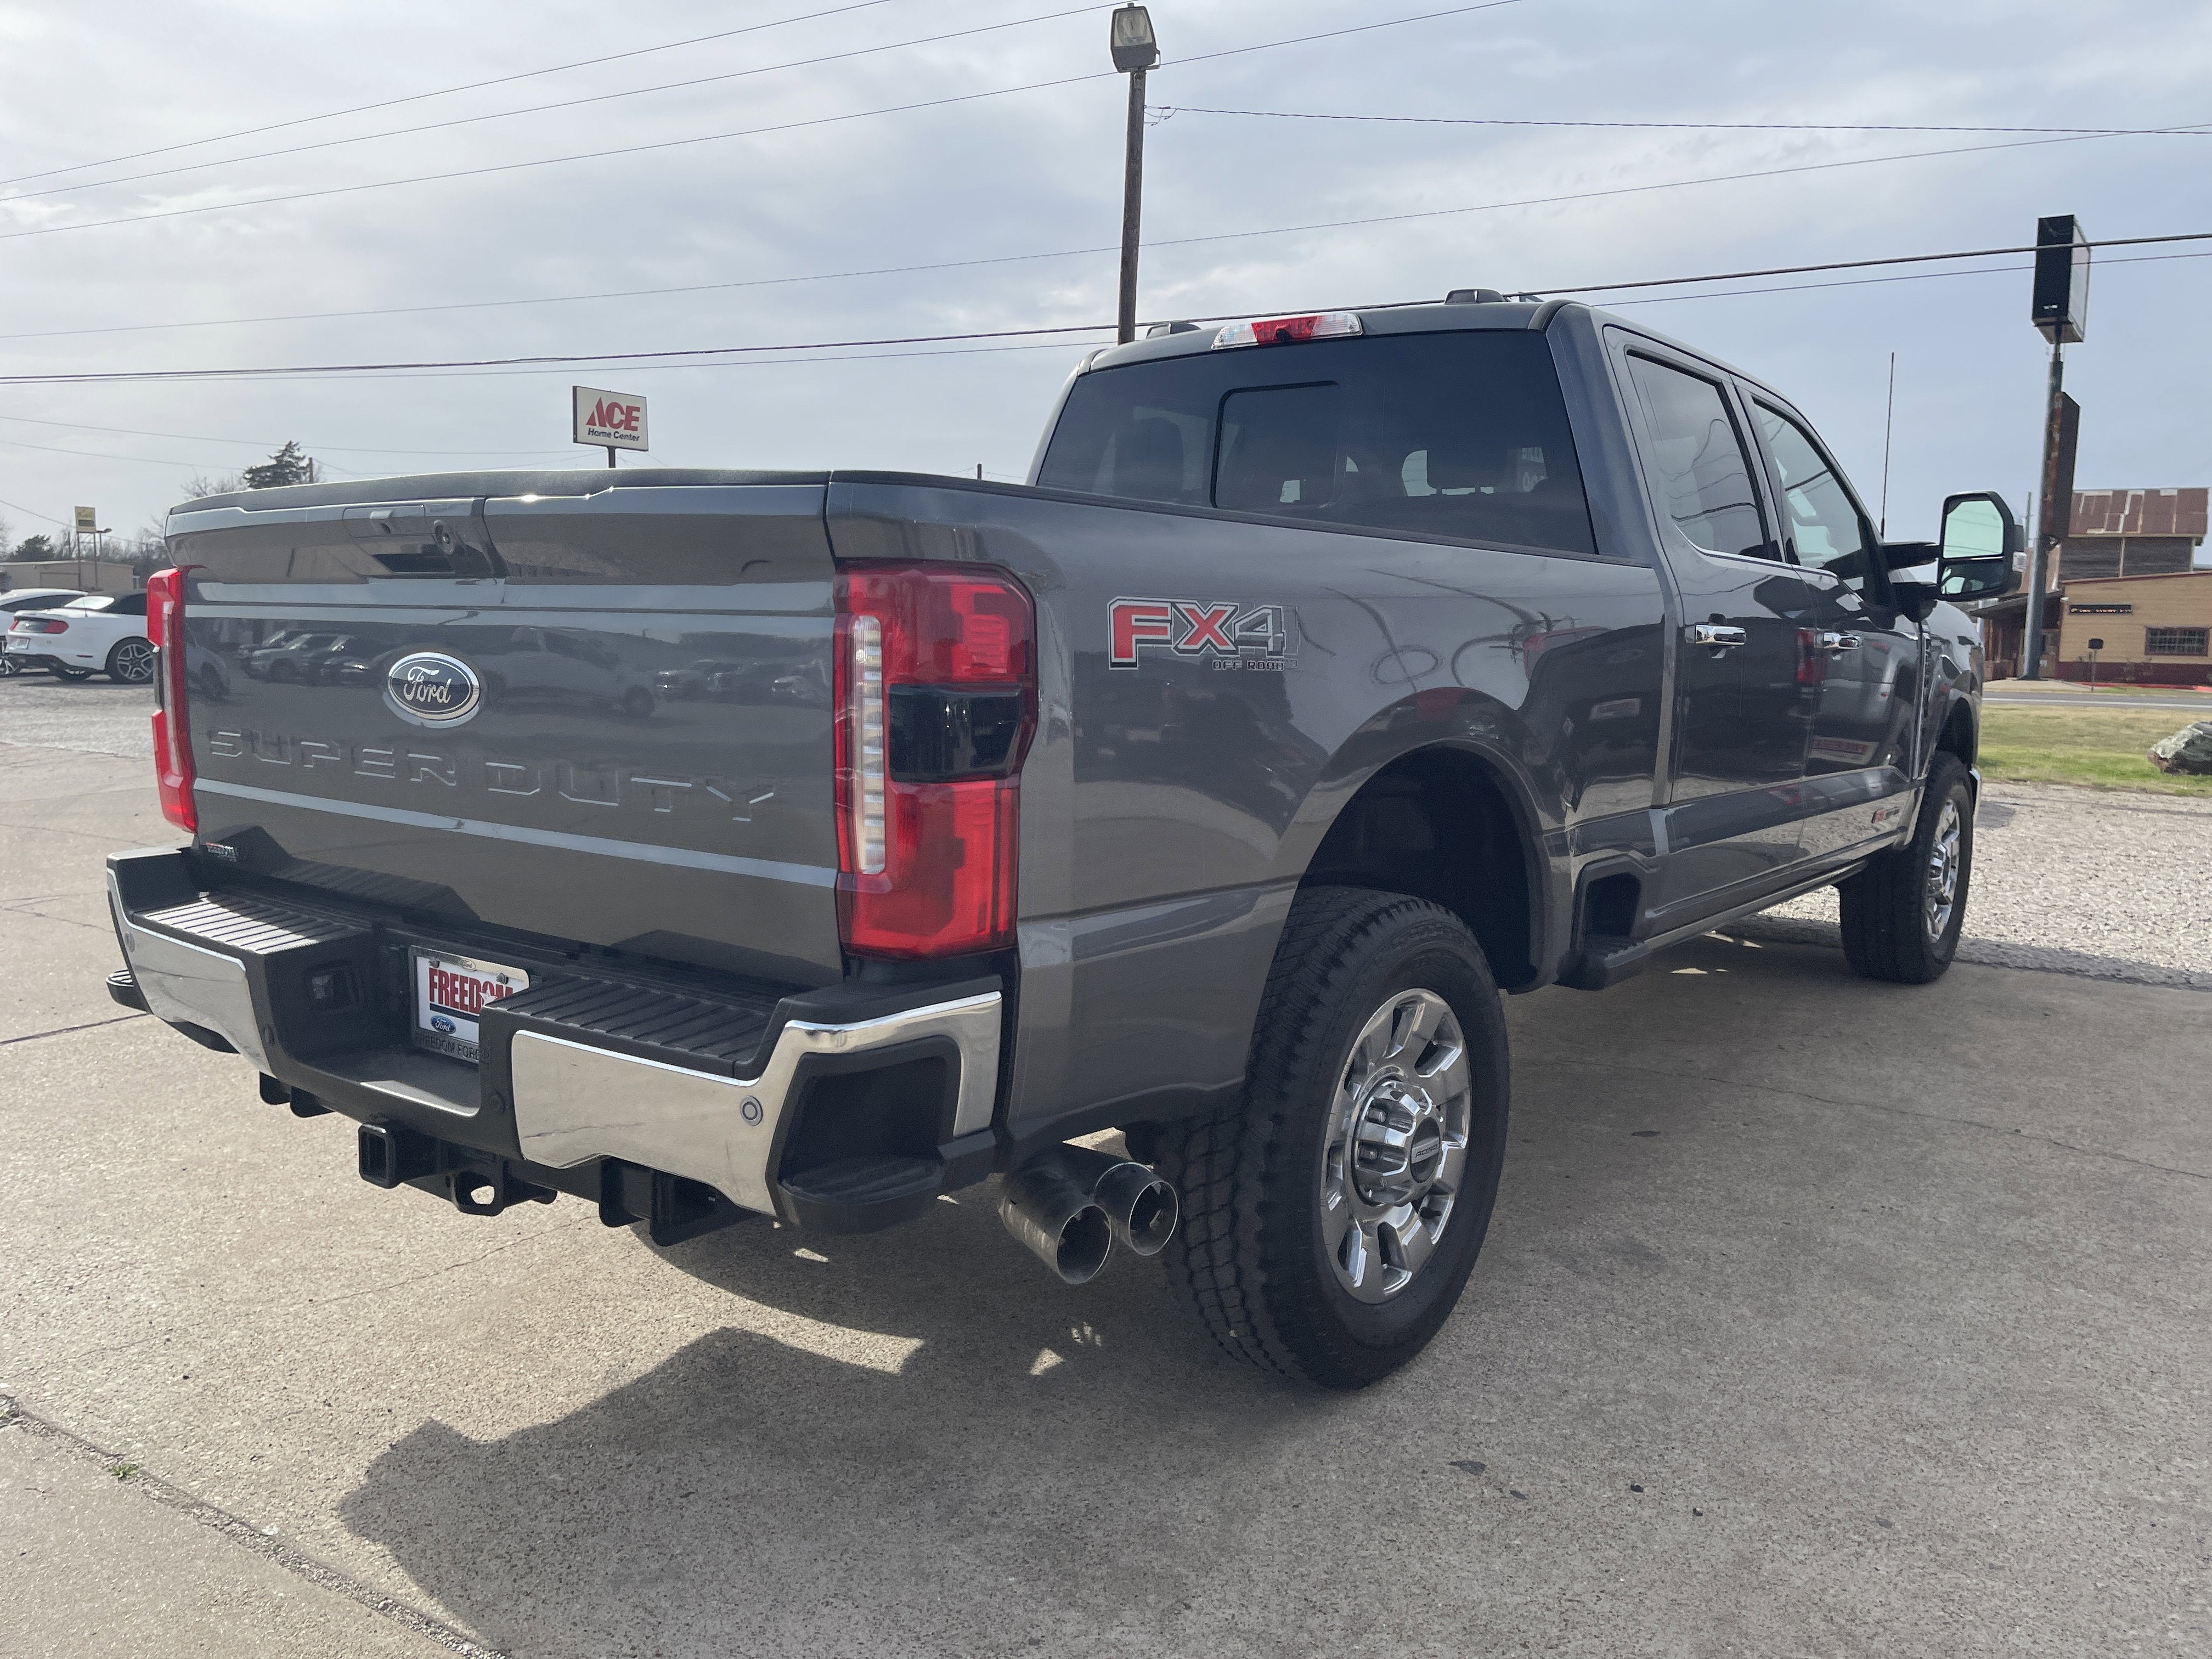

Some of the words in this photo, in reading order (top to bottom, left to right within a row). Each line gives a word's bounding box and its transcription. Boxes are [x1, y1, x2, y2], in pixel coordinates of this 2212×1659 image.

[586, 396, 641, 432] ACE
[588, 427, 612, 438] Home
[613, 431, 640, 442] Center
[1107, 596, 1286, 670] FX4
[1212, 659, 1243, 671] OFF
[1246, 661, 1285, 672] ROAD
[403, 666, 452, 704] Ford
[208, 730, 457, 787] SUPER
[485, 760, 775, 822] DUTY
[435, 1018, 451, 1032] Ford
